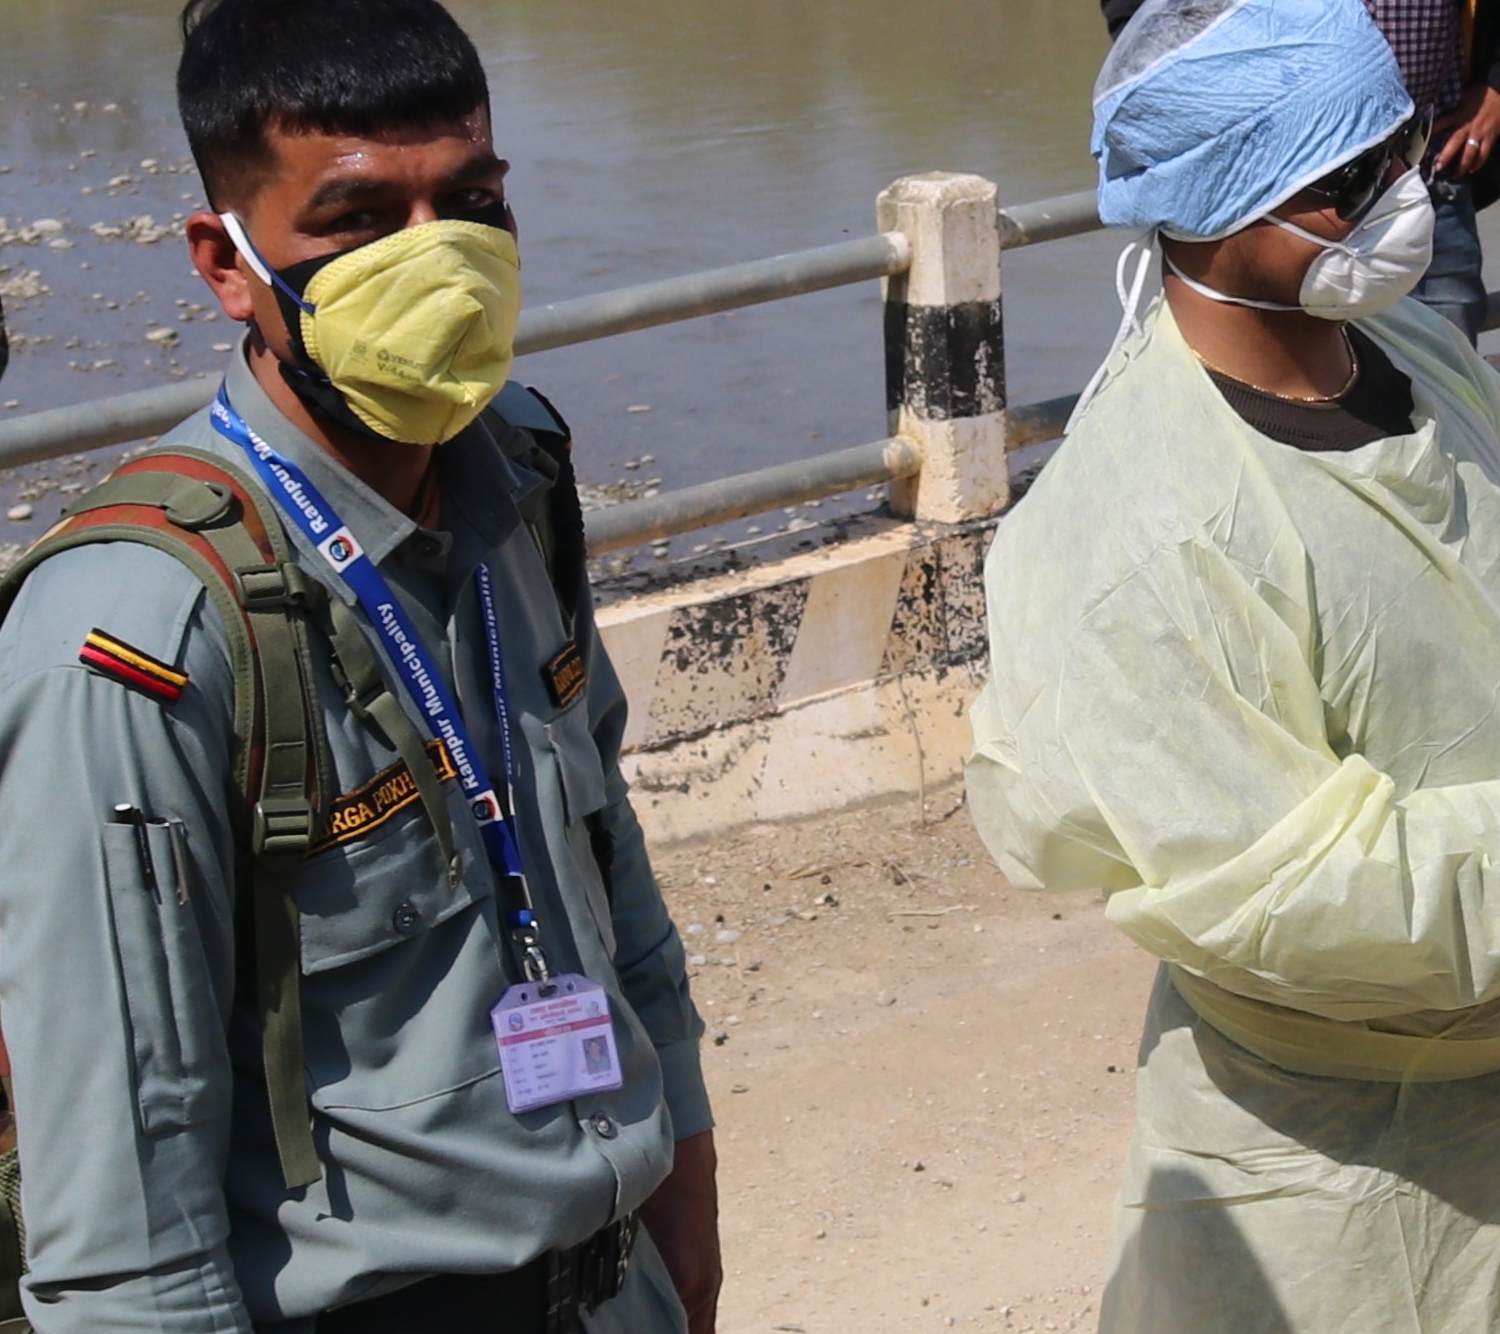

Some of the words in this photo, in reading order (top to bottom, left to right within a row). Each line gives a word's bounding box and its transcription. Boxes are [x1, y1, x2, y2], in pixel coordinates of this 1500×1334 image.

[269, 463, 329, 534] Rampur
[377, 603, 444, 717] Municipality
[437, 718, 479, 791] Rampur
[327, 802, 376, 835] RGA
